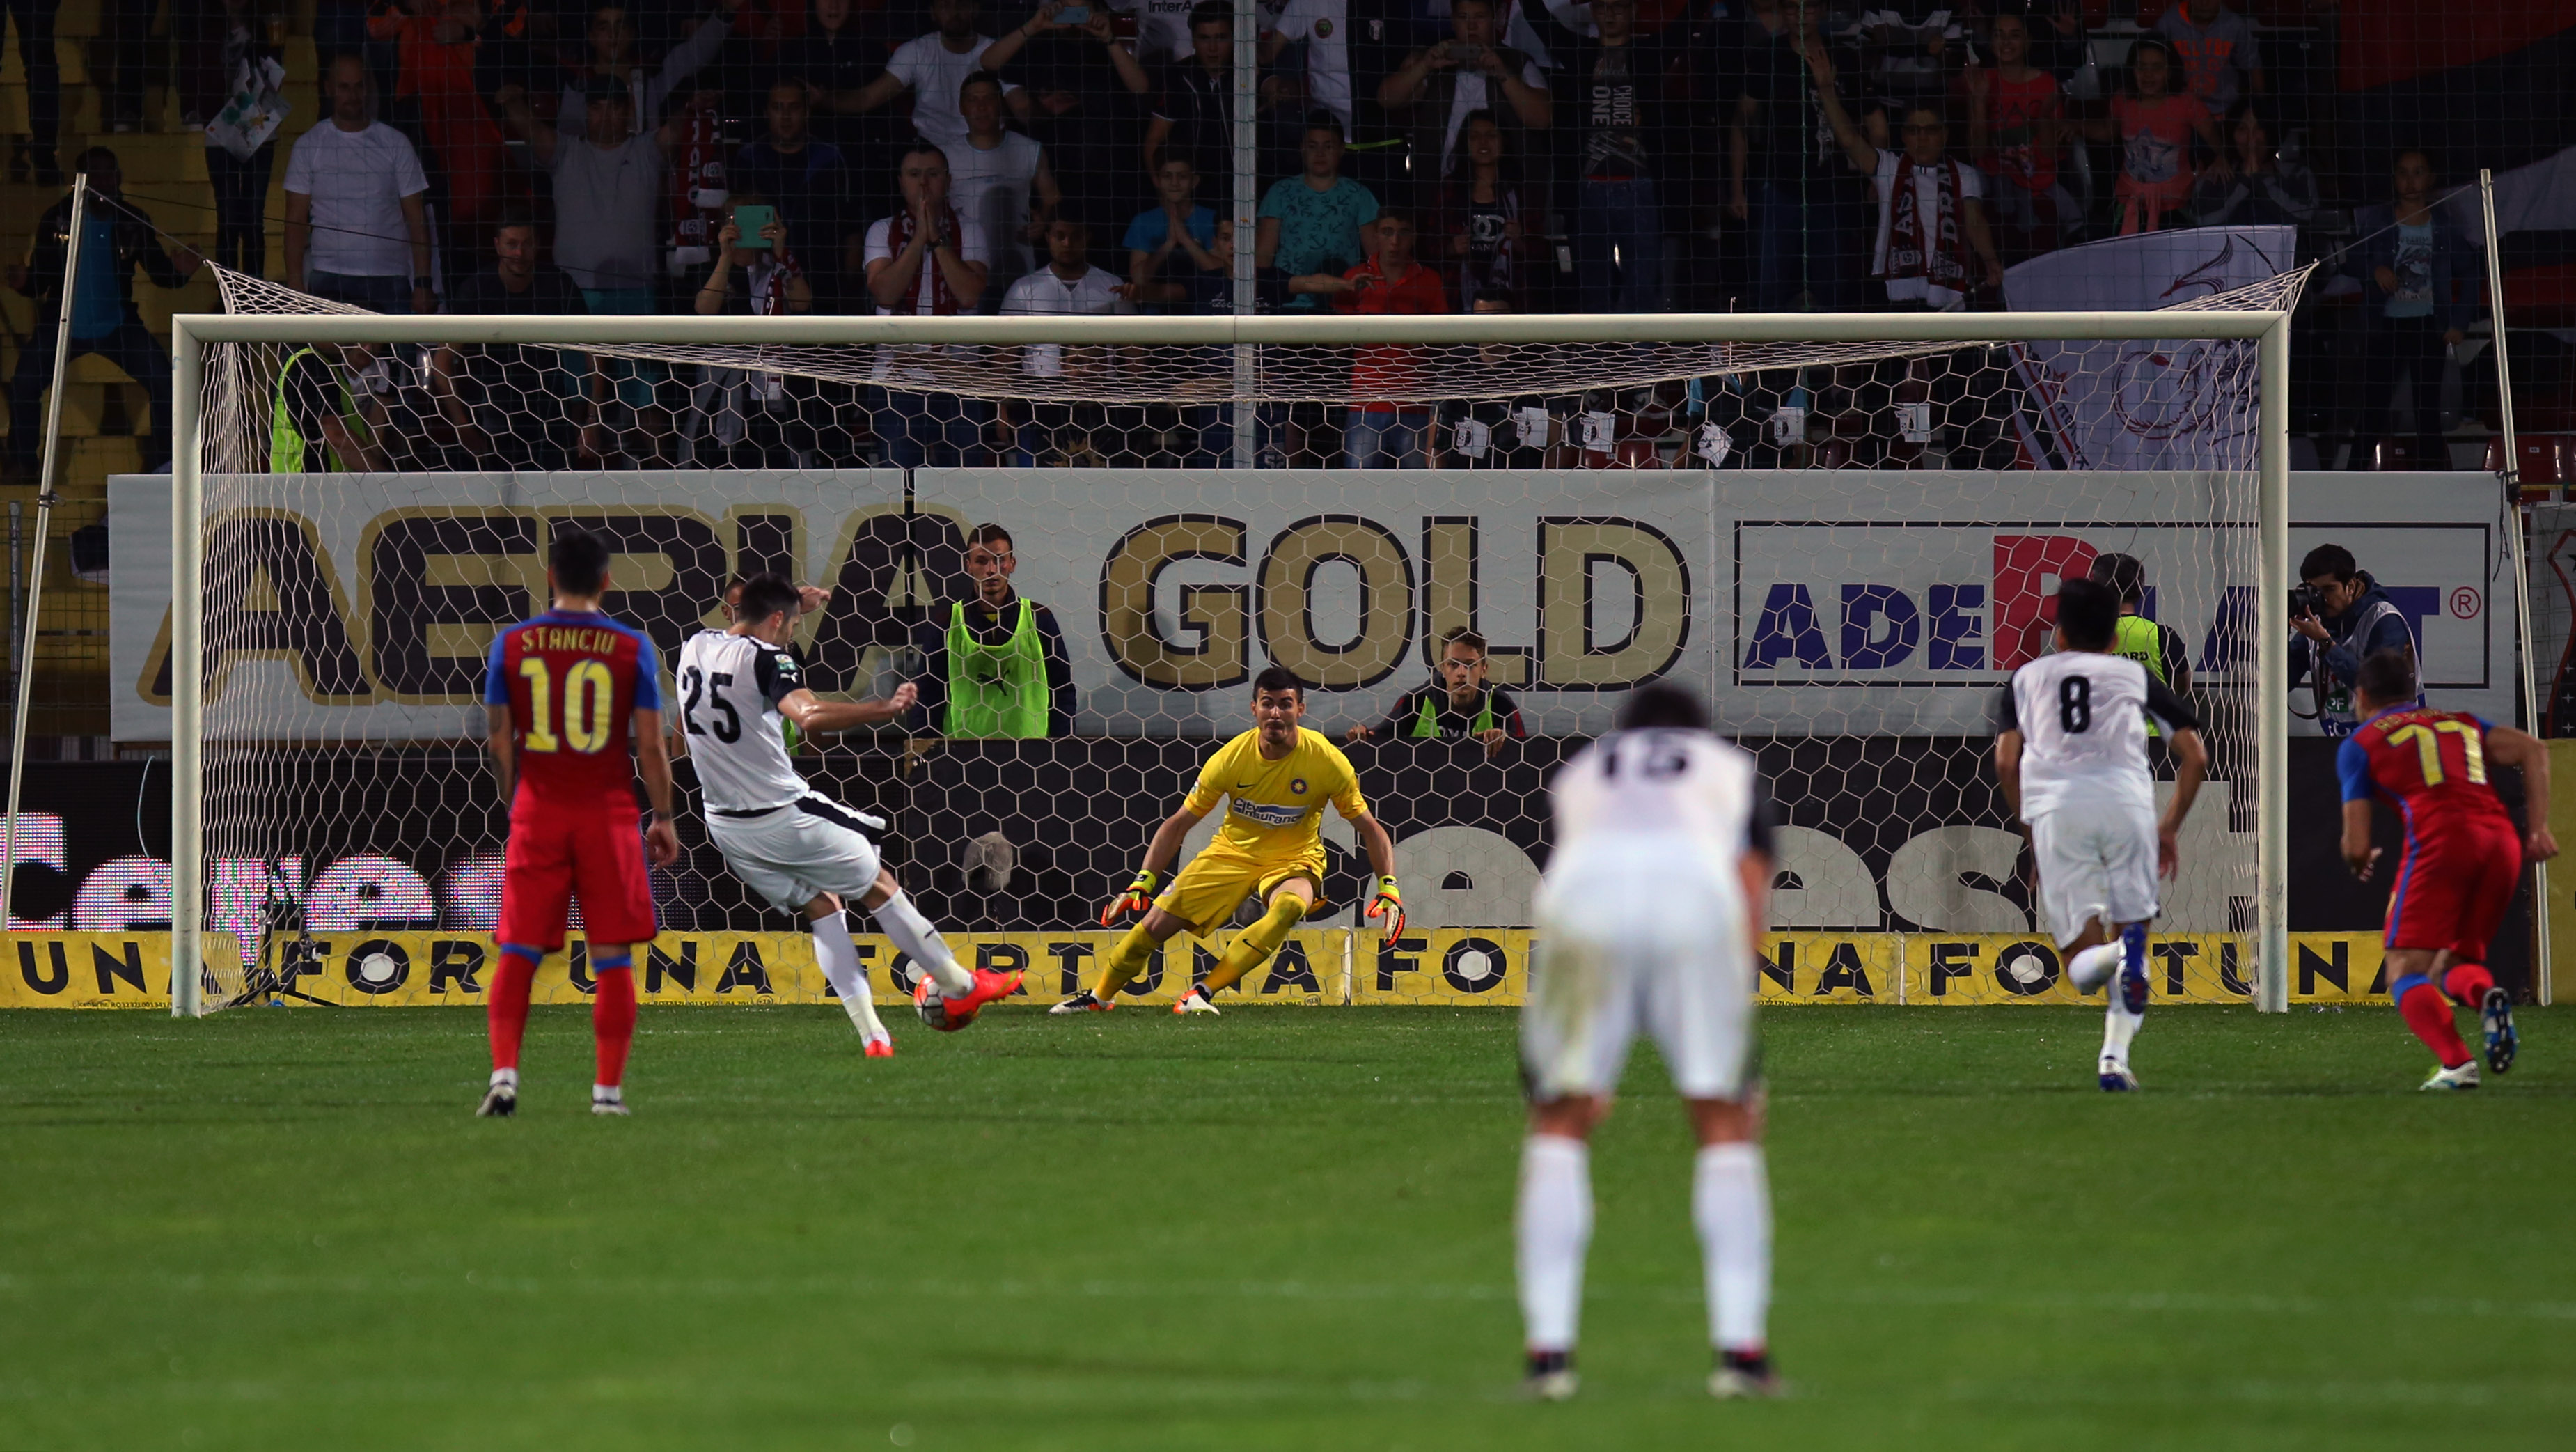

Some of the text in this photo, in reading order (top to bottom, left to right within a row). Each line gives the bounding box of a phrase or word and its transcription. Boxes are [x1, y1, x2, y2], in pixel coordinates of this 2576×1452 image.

[1592, 85, 1612, 126] ONE
[1612, 84, 1633, 126] CHOICE
[1098, 513, 1691, 692] GOLD
[521, 625, 618, 656] STANCIU
[519, 657, 614, 754] 10
[682, 664, 741, 744] 25
[2060, 675, 2091, 733] 8
[2386, 719, 2488, 788] 77
[1234, 797, 1259, 813] City
